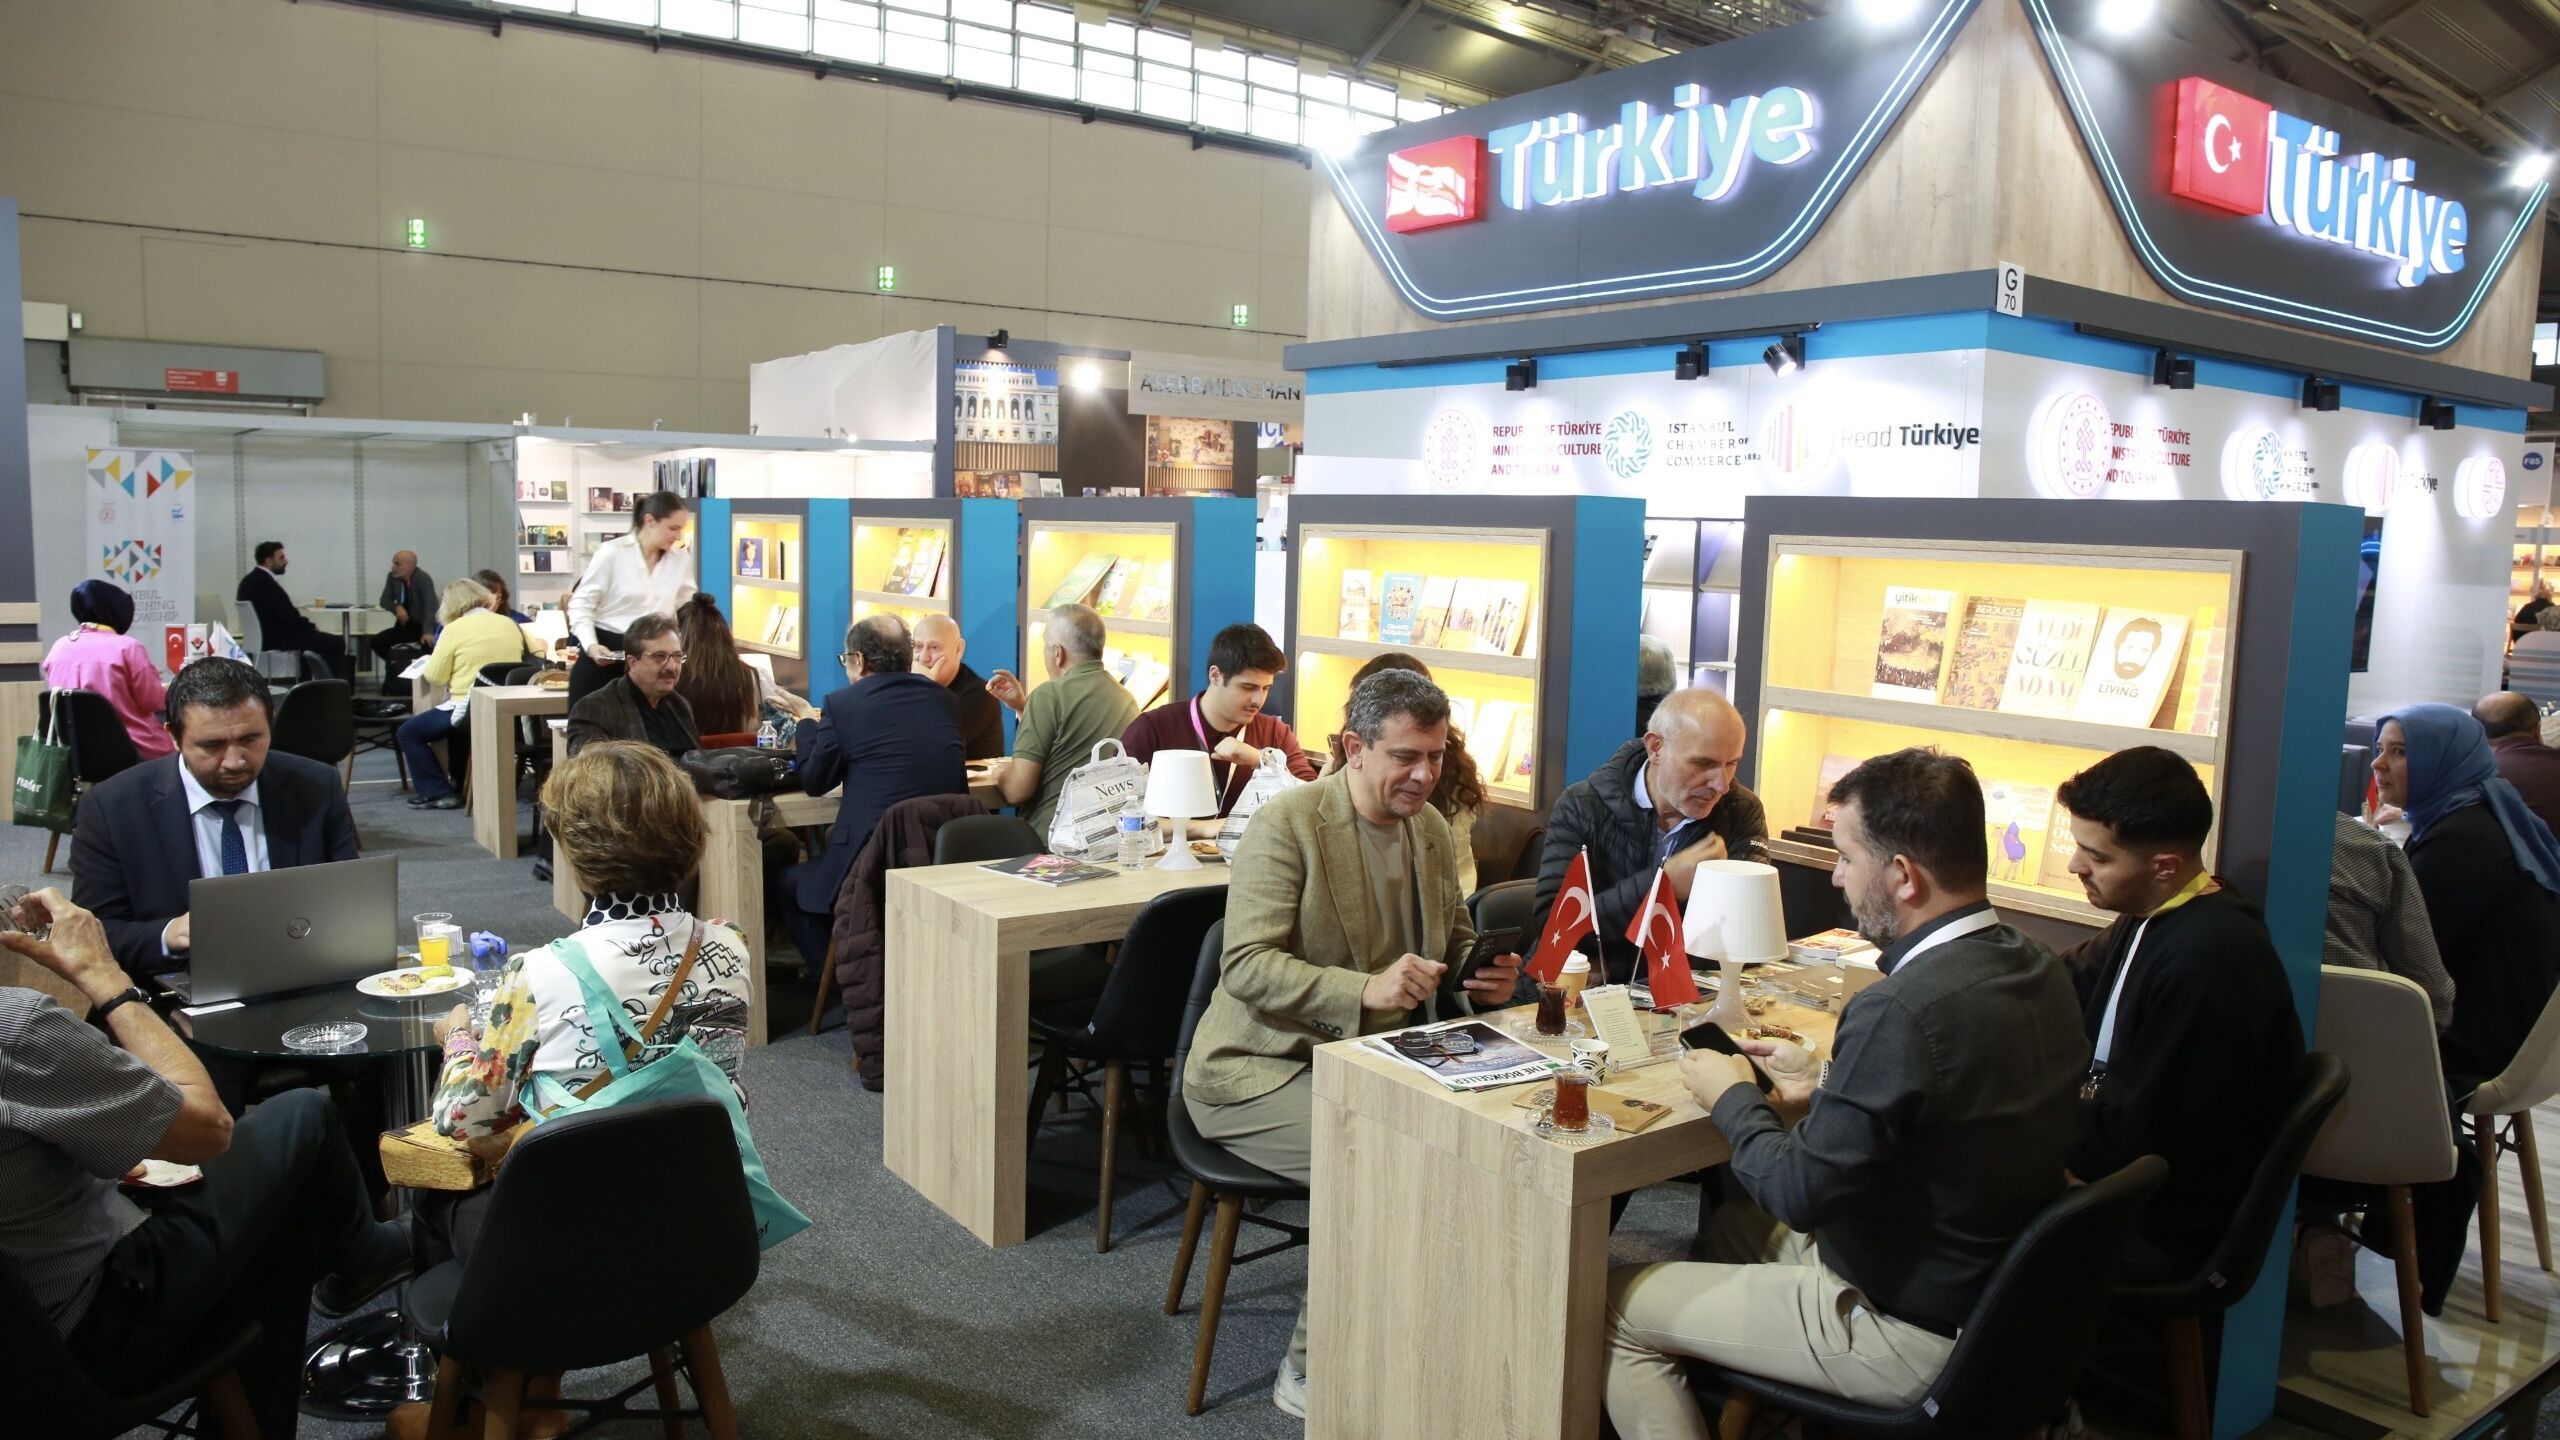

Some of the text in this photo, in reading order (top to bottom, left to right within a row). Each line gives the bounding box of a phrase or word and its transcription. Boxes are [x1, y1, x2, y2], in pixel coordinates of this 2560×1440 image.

[1488, 83, 1814, 211] Türkiye
[2267, 110, 2468, 288] Türkiye
[2005, 268, 2018, 291] G
[2004, 293, 2017, 310] 70
[1558, 421, 1602, 436] TÜRKİYE
[1899, 422, 1980, 450] Türkiye
[1738, 437, 1750, 445] OF
[2105, 468, 2118, 483] ND
[2099, 683, 2140, 699] LIVING
[1095, 779, 1135, 801] News
[1451, 1064, 1548, 1085] THE BOOKSELLER
